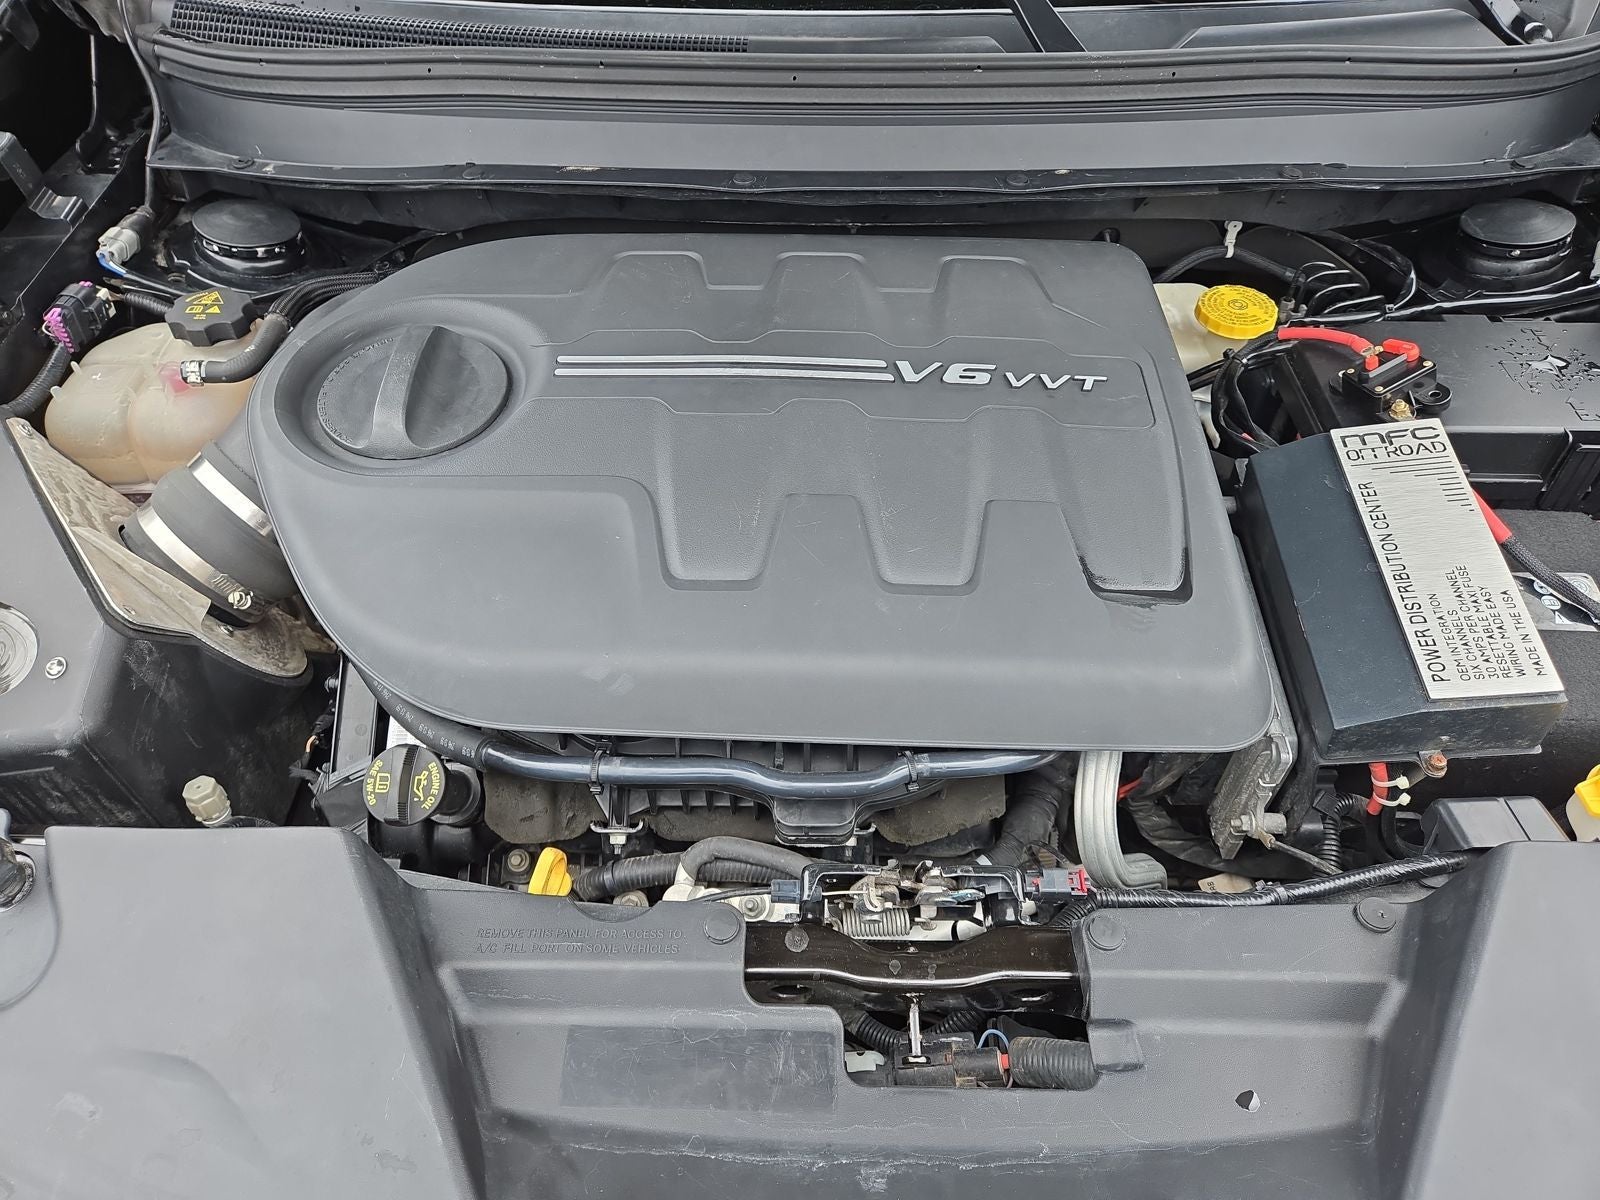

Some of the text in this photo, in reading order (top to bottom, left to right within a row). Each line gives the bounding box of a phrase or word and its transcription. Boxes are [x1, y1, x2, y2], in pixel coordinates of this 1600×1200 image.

[895, 360, 1108, 391] V6 VVT
[322, 418, 353, 443] SERVICE
[1359, 481, 1452, 682] POWER DISTRIBUTION CENTER
[1427, 593, 1471, 681] OEM INTEGRATION
[1445, 569, 1500, 679] 30 AMPS PER CHANNEL
[1447, 610, 1485, 680] SIX CHANNELS
[1456, 565, 1513, 678] RESETTABLE MAXI FUSE
[1478, 585, 1527, 677] WIRING MADE EASY
[1500, 590, 1548, 676] MADE IN THE USA
[366, 760, 383, 806] SAE 5W-20
[421, 761, 440, 810] ENGINE OIL
[475, 942, 680, 954] A/C FILL PORT ON SOME VEHICLES
[476, 928, 683, 939] REMOVE THIS PANEL FOR ACCESS TO
